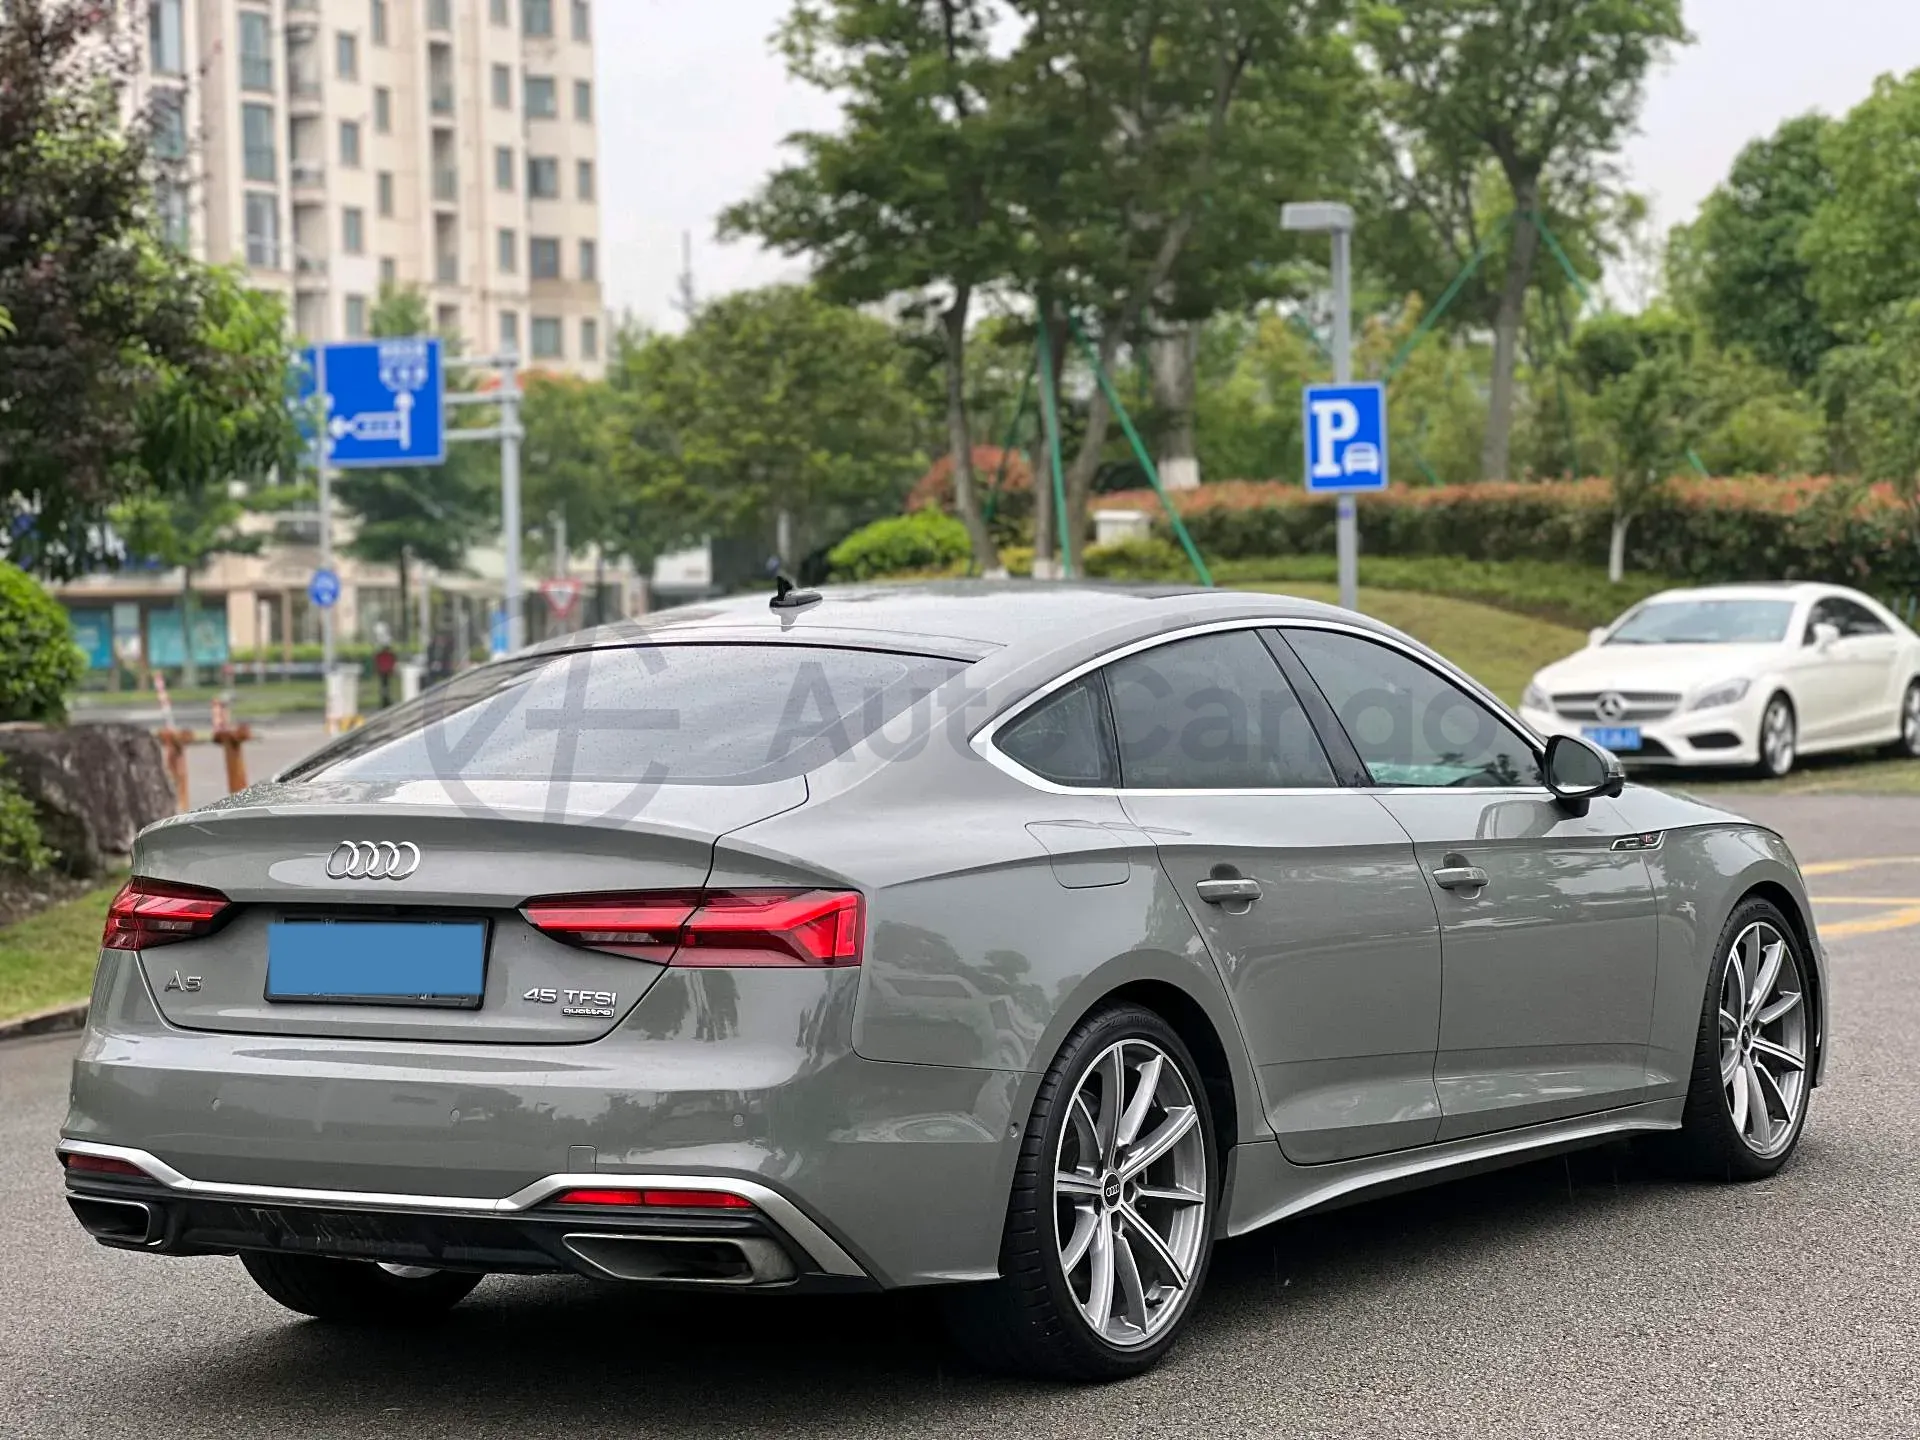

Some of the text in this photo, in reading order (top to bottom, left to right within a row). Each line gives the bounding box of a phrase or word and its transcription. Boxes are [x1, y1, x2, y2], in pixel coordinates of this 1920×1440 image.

[1311, 399, 1359, 477] P
[164, 969, 202, 992] A5
[523, 987, 617, 1006] 45 TFSI
[562, 1007, 613, 1017] quattro
